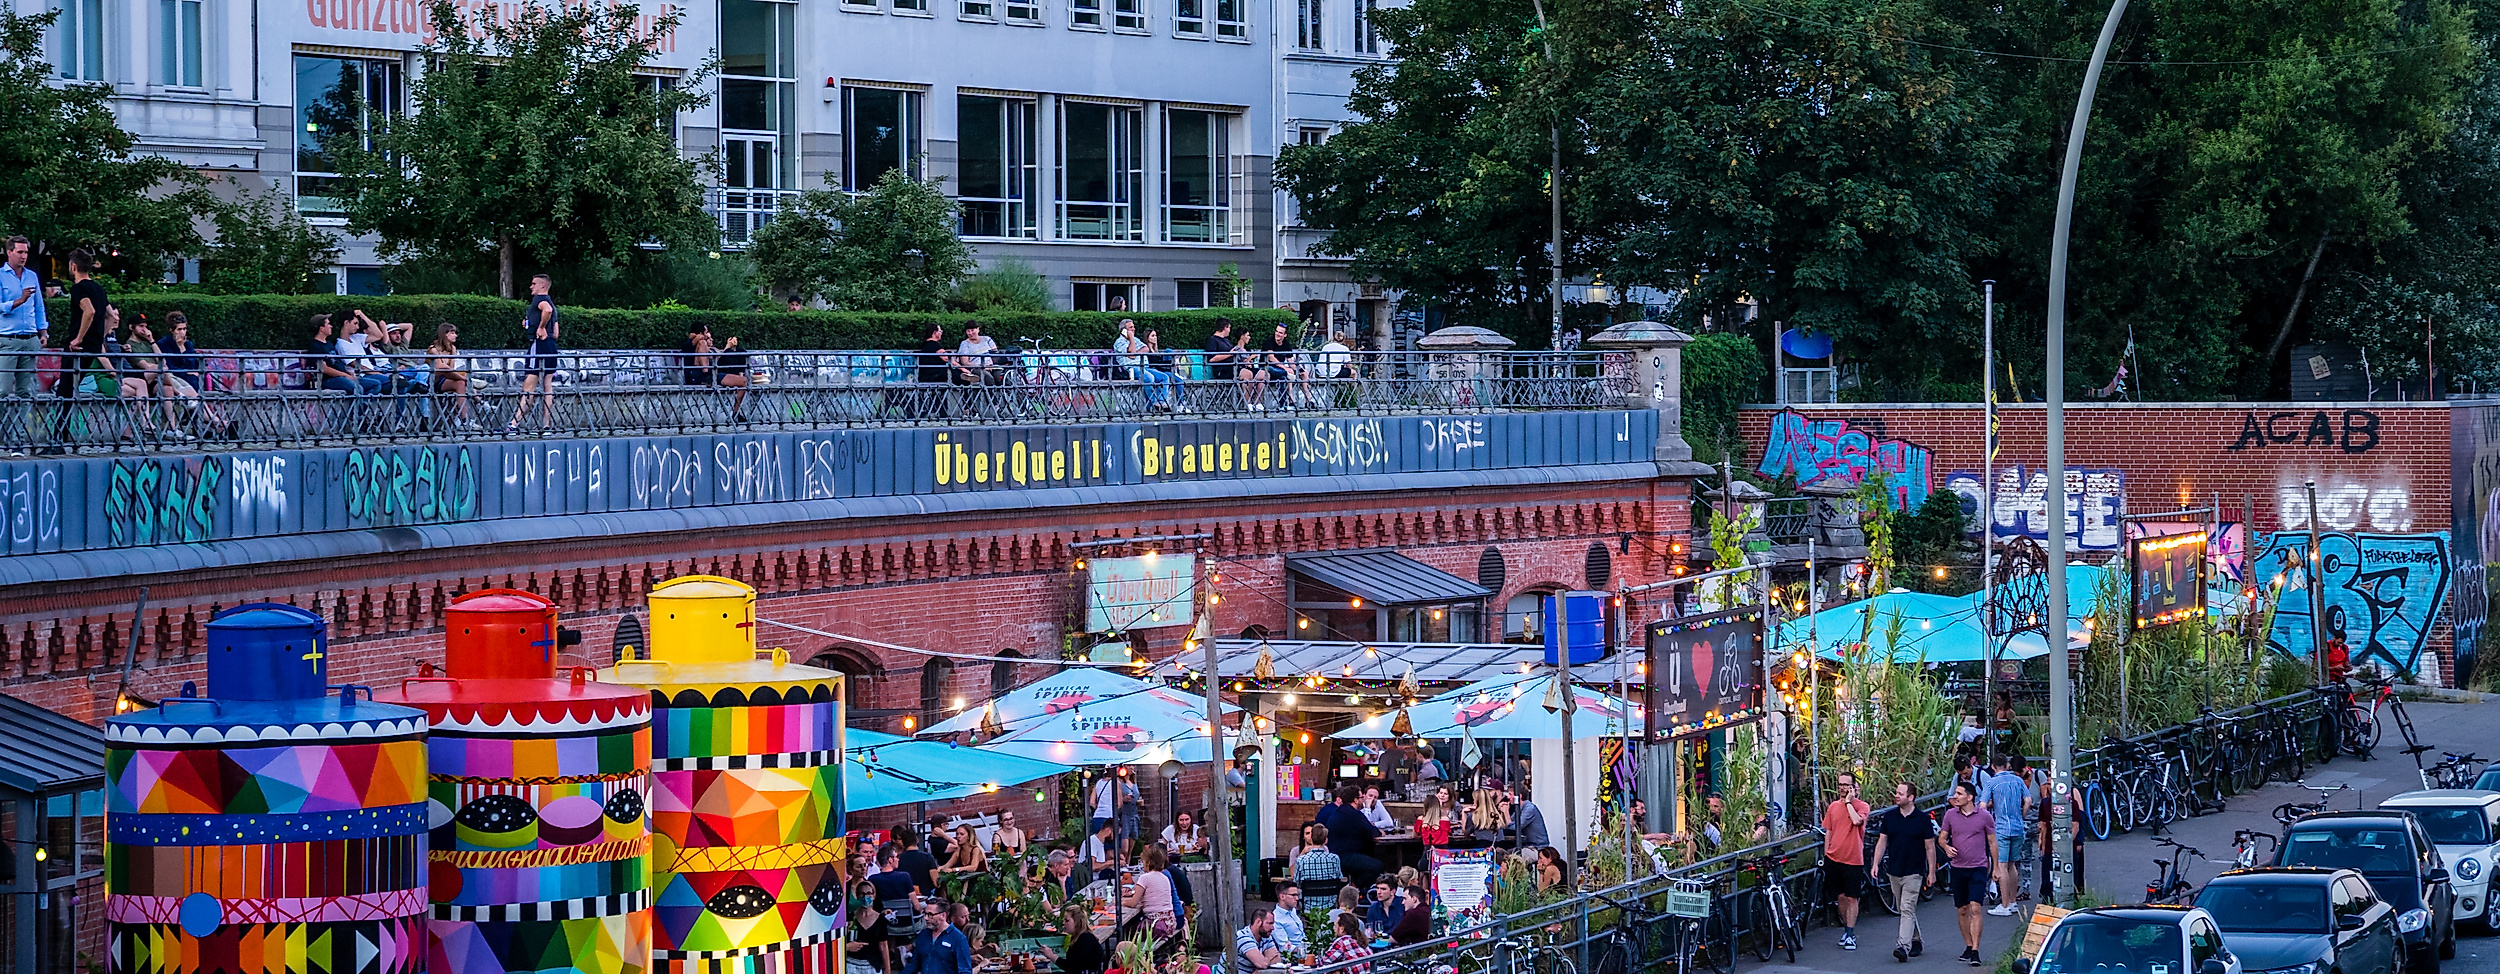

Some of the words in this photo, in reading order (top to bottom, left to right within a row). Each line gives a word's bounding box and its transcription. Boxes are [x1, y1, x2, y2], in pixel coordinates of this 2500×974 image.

[2227, 410, 2381, 453] ACAB
[505, 445, 603, 492] UNFUG
[935, 435, 1099, 486] ÜberQuell
[1144, 432, 1286, 476] Brauerei
[1107, 566, 1178, 604] ÜberQuell
[1146, 603, 1176, 622] PZZA
[1034, 690, 1088, 699] SPIRIT
[1071, 721, 1131, 730] SPIRIT
